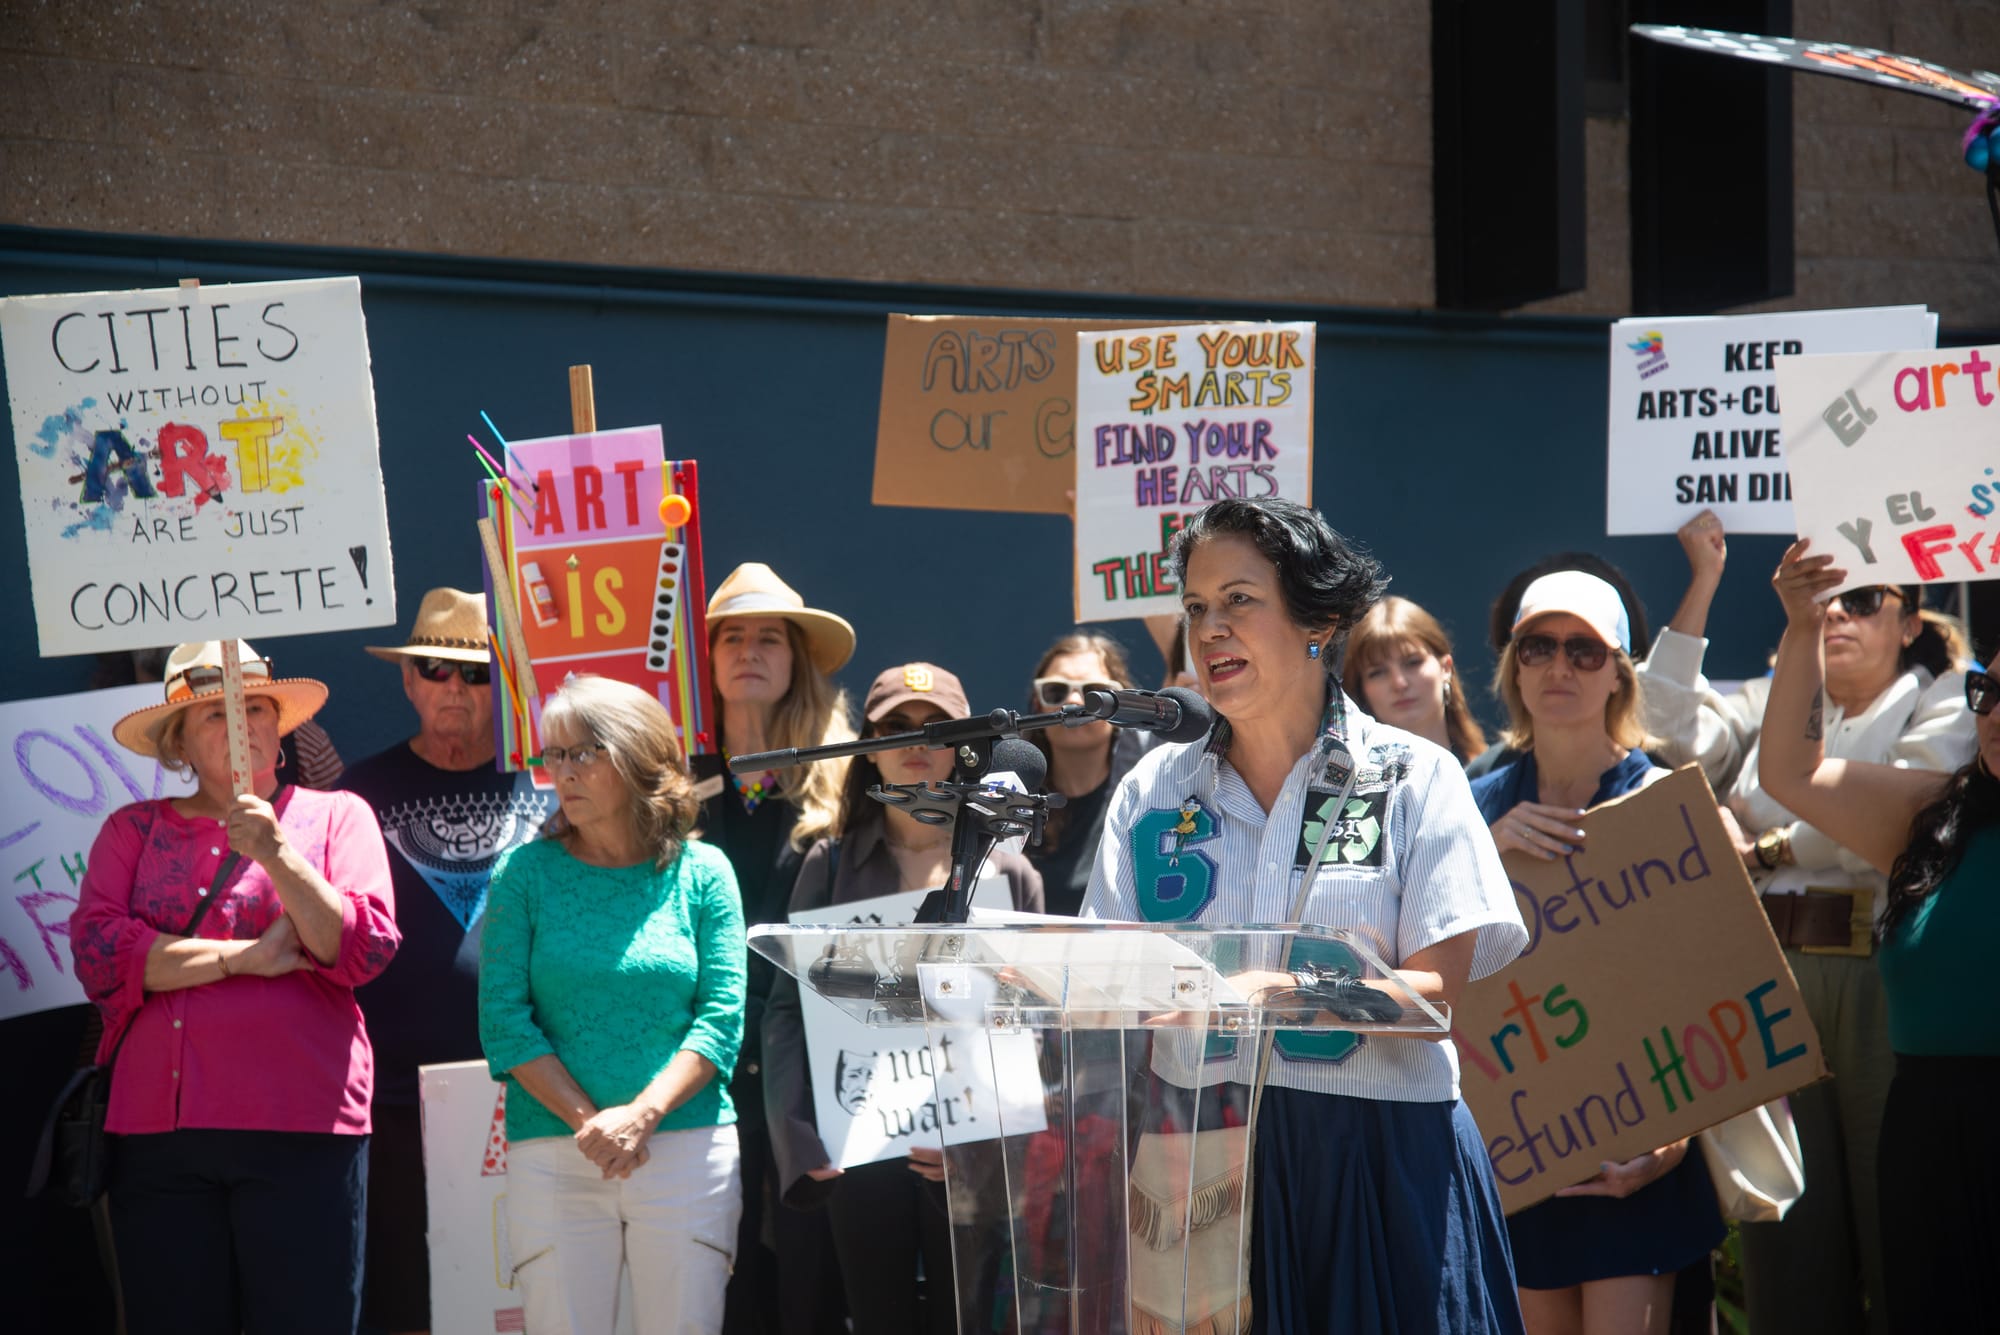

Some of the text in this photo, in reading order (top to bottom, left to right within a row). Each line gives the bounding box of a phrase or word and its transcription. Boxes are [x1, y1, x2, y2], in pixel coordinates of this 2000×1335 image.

[52, 302, 299, 374] CITIES
[922, 328, 1056, 394] ARTS
[1095, 330, 1306, 376] USE YOUR
[107, 380, 267, 414] WITHOUT
[1894, 350, 2000, 412] art
[79, 416, 285, 505] ART
[1094, 418, 1279, 468] FIND YOUR
[1692, 429, 1781, 461] ALIVE
[533, 459, 645, 536] ART
[1135, 463, 1280, 508] HEARTS
[1676, 473, 1739, 504] SAN
[131, 507, 305, 544] ARE JUST
[1836, 517, 1877, 564] Y
[70, 545, 375, 630] CONCRETE!
[888, 1033, 954, 1083] not
[1643, 979, 1807, 1113] HOPE
[877, 1086, 976, 1139] war!
